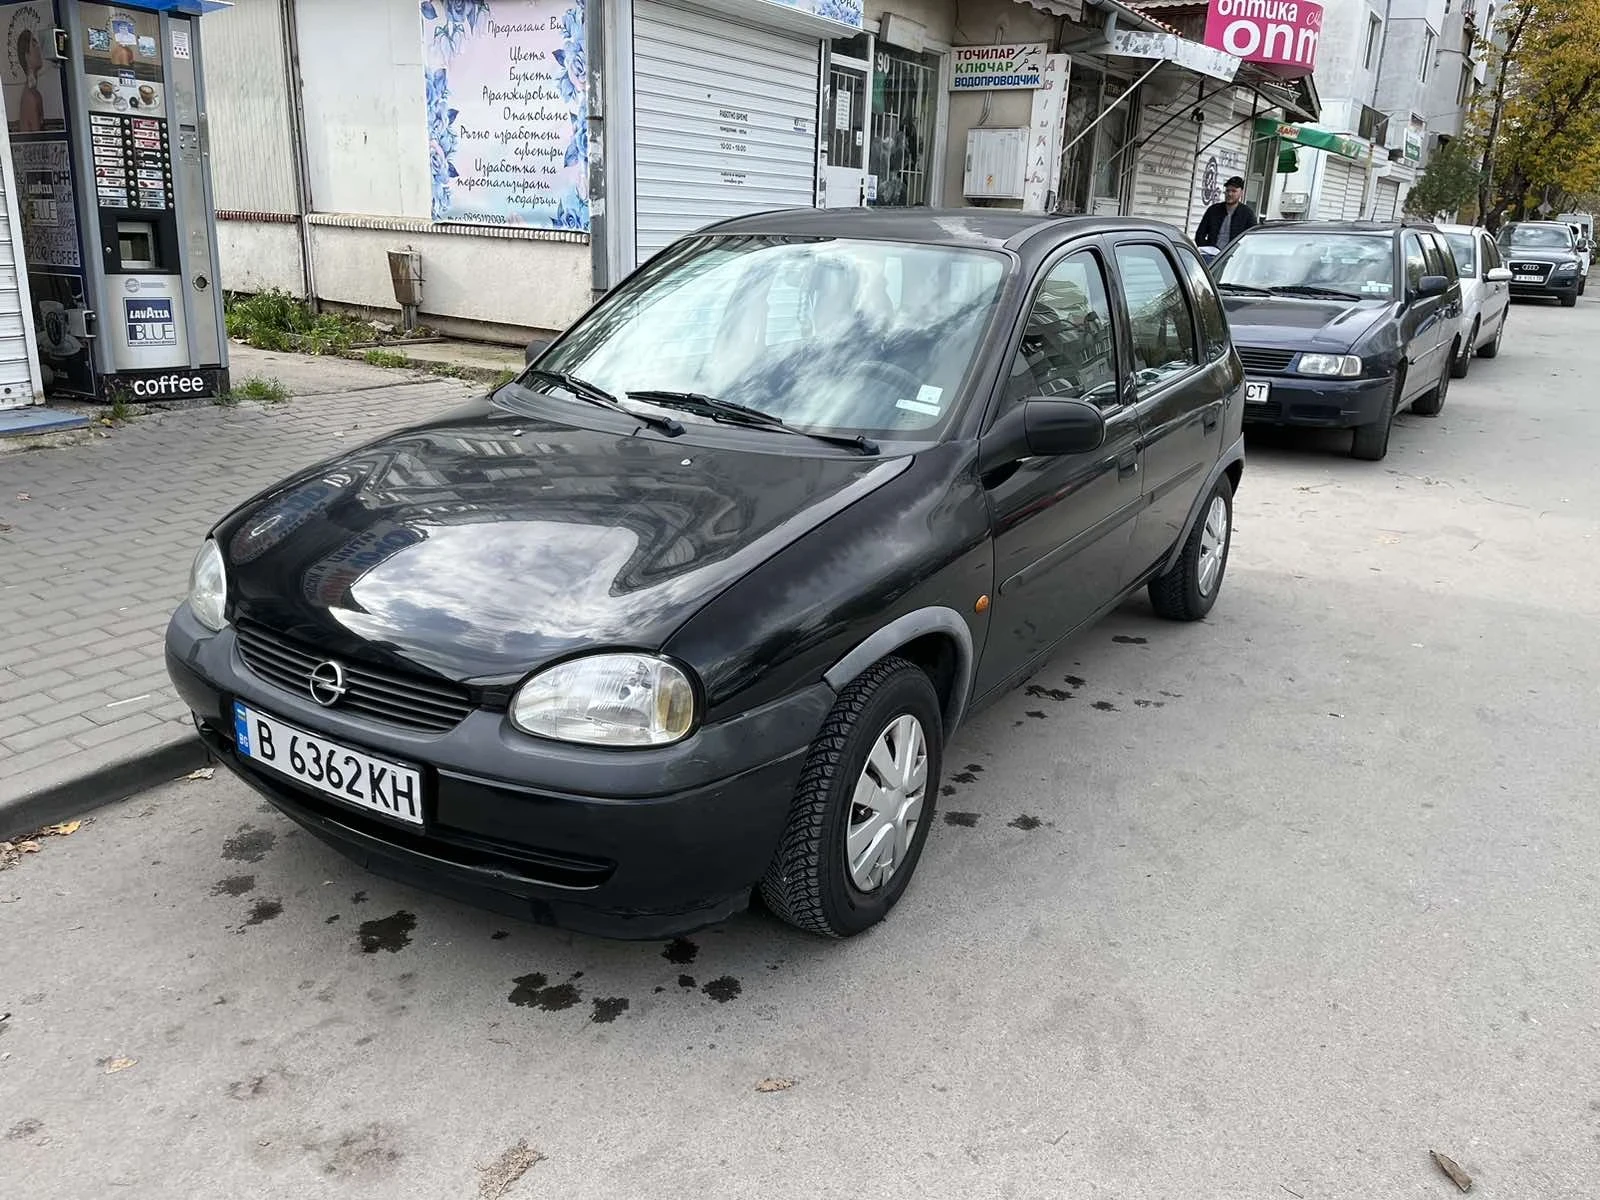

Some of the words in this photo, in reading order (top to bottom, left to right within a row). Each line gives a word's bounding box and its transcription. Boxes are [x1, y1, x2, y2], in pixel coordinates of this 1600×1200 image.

[1217, 0, 1298, 22] оптика
[487, 20, 546, 38] Предлагаме
[509, 46, 545, 63] Цветя
[957, 47, 1015, 61] ТОЧИЛАР
[509, 66, 552, 86] Букети
[955, 61, 1013, 74] КЛЮЧАР
[954, 74, 1040, 88] ВОДОПРОВОДЧИК
[482, 85, 560, 105] Аранжировки
[503, 106, 569, 121] Опаковане
[460, 125, 490, 140] Ръчно
[494, 125, 560, 144] изработени
[513, 141, 564, 162] сувенири
[474, 158, 536, 175] Изработка
[540, 165, 557, 175] на
[457, 177, 550, 192] персонализирани
[506, 195, 558, 209] подаръци
[129, 306, 170, 319] LAVAZZA
[131, 324, 175, 340] BLUE
[134, 375, 204, 395] coffee
[239, 732, 249, 748] BG
[256, 719, 276, 761] B
